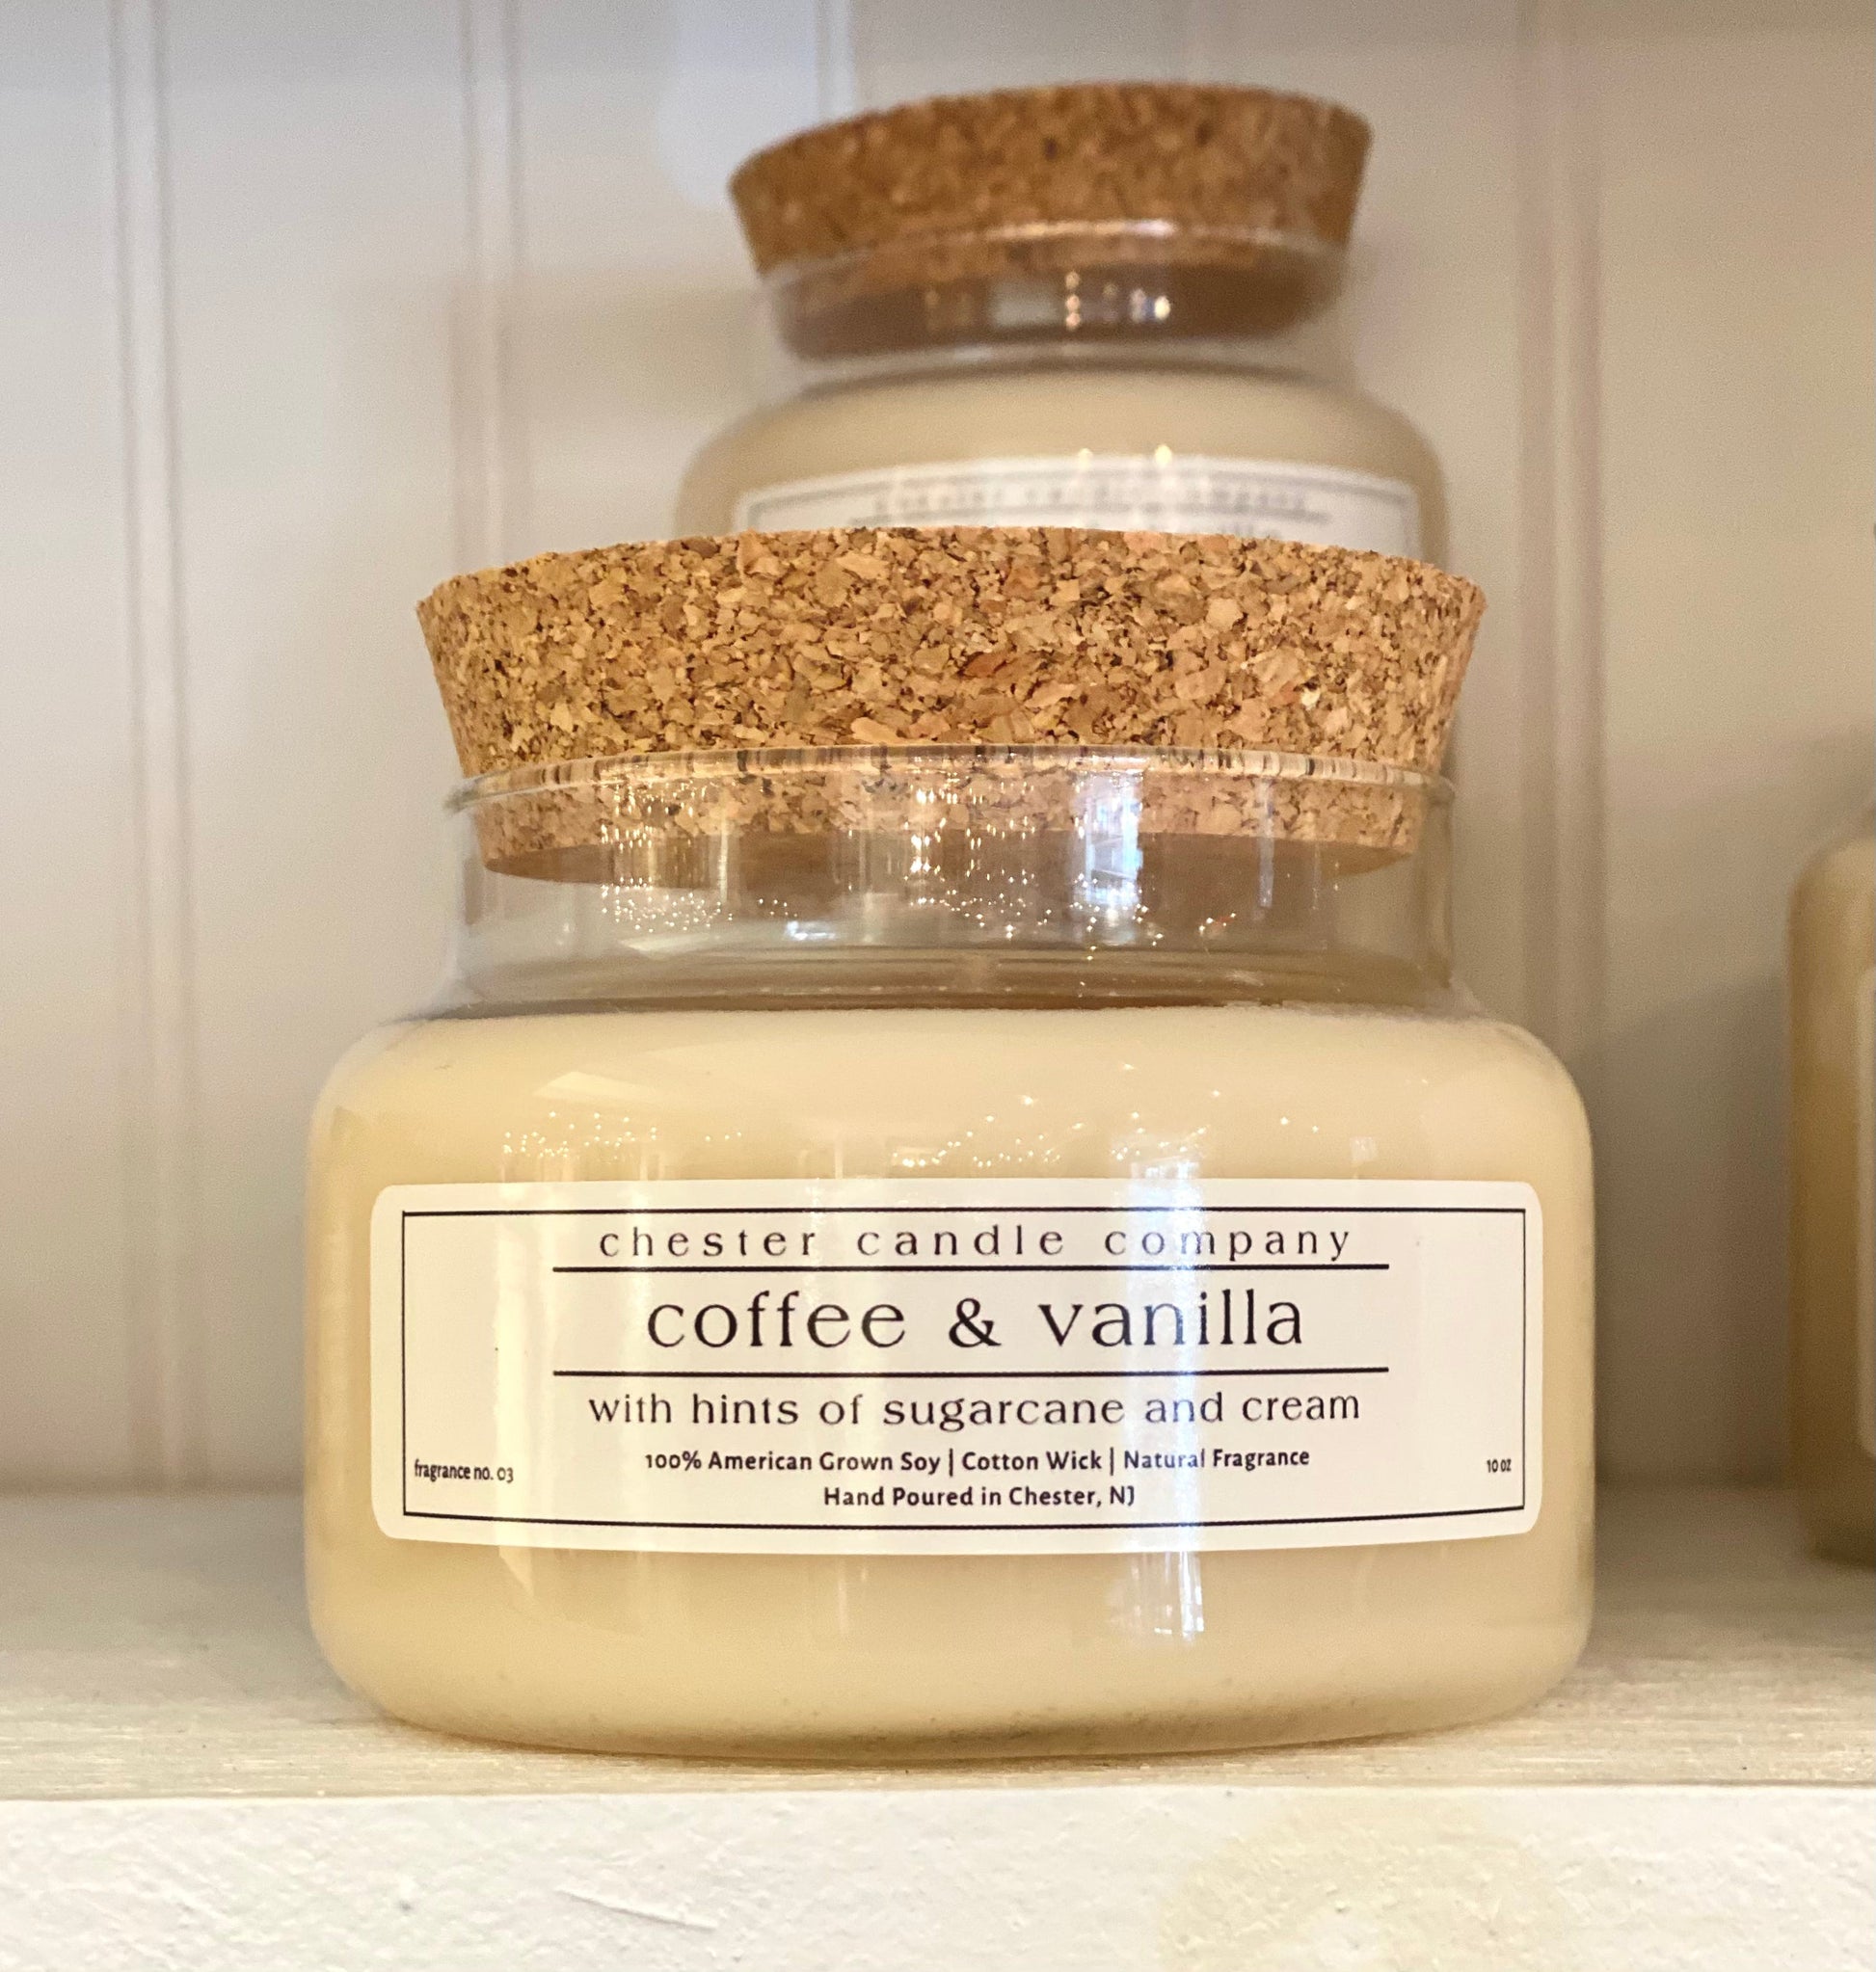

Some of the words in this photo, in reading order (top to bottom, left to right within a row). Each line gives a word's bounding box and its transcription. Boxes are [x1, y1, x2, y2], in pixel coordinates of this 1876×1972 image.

[599, 1225, 817, 1258] chester
[856, 1223, 1064, 1257] candle
[1104, 1230, 1351, 1263] company
[647, 1289, 906, 1349] coffee
[948, 1296, 1003, 1349] &
[1036, 1287, 1303, 1348] vanilla
[587, 1392, 672, 1425] with
[691, 1392, 799, 1426] hints
[817, 1393, 864, 1426] of
[882, 1397, 1125, 1434] sugarcane
[1144, 1390, 1224, 1425] and
[1241, 1394, 1360, 1423] cream
[414, 1457, 471, 1483] fragrance
[472, 1465, 495, 1481] no.
[496, 1466, 515, 1484] 03
[644, 1450, 703, 1473] 100%
[707, 1450, 813, 1472] American
[817, 1451, 894, 1472] Grown
[899, 1451, 942, 1477] Soy
[960, 1451, 1039, 1472] Cotton
[1045, 1449, 1103, 1471] Wick
[1123, 1447, 1206, 1470] Natural
[1212, 1448, 1310, 1473] Fragrance
[1487, 1458, 1499, 1473] 10
[823, 1484, 886, 1507] Hand
[892, 1485, 975, 1507] Poured
[980, 1485, 1003, 1506] in
[1007, 1484, 1103, 1509] Chester,
[1109, 1484, 1136, 1507] NJ
